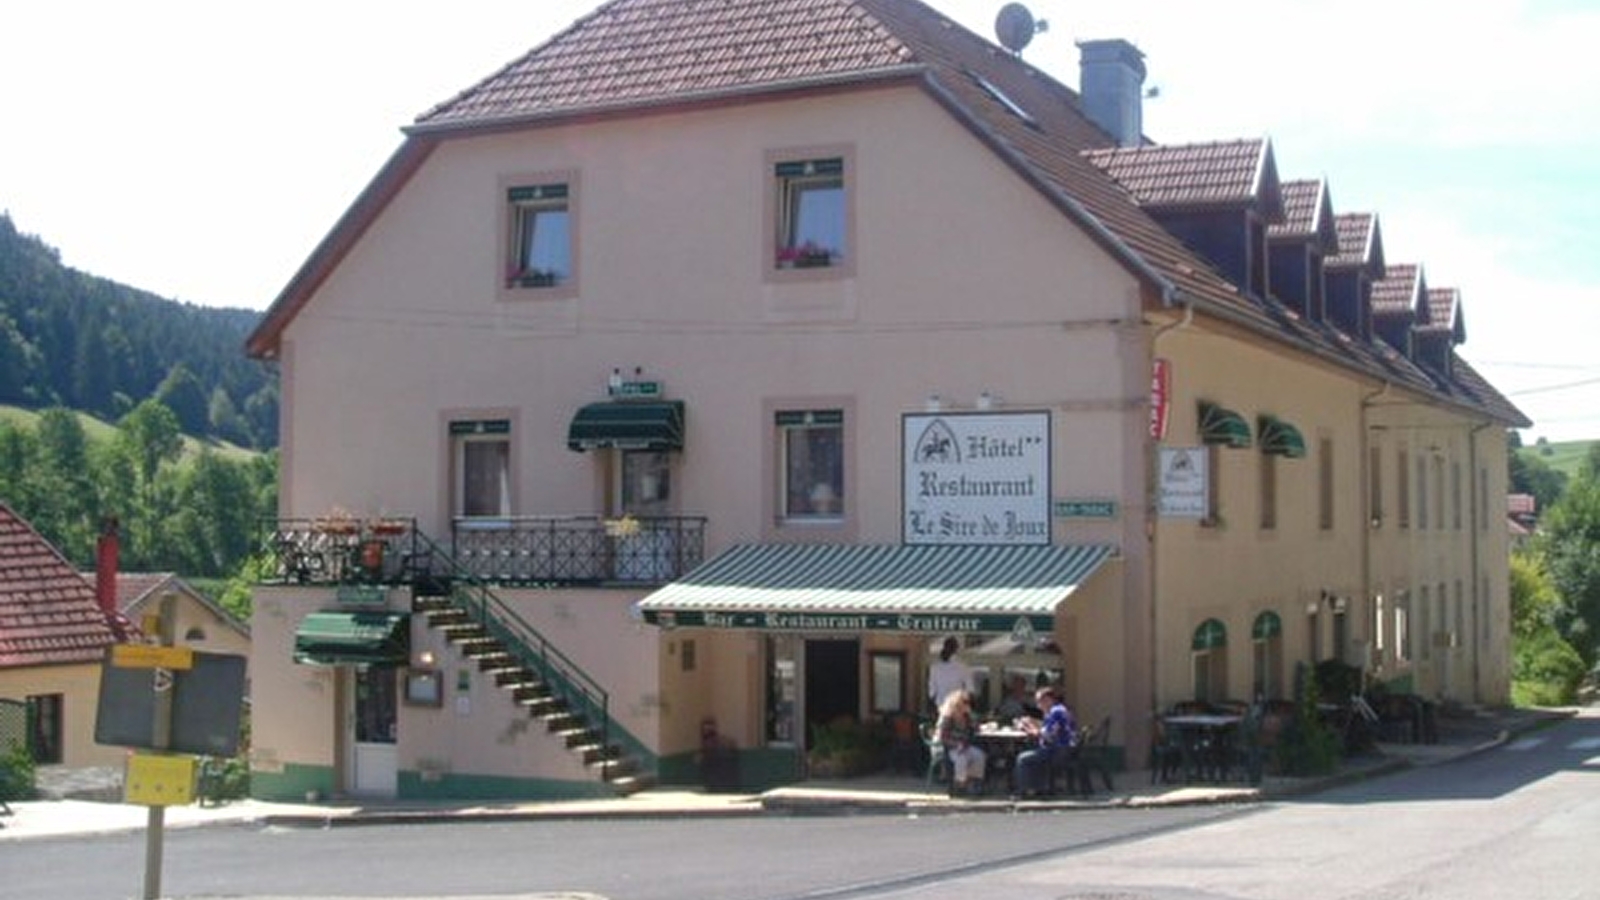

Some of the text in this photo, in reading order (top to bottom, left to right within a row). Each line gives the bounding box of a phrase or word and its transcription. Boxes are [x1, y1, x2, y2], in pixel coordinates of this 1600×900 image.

[1150, 361, 1162, 436] TABAC
[919, 470, 1034, 497] Restaurant
[909, 510, 1046, 540] Le Sire de Joux
[704, 611, 734, 628] Bar
[765, 611, 868, 630] Restaurant
[897, 614, 982, 631] Traiteur
